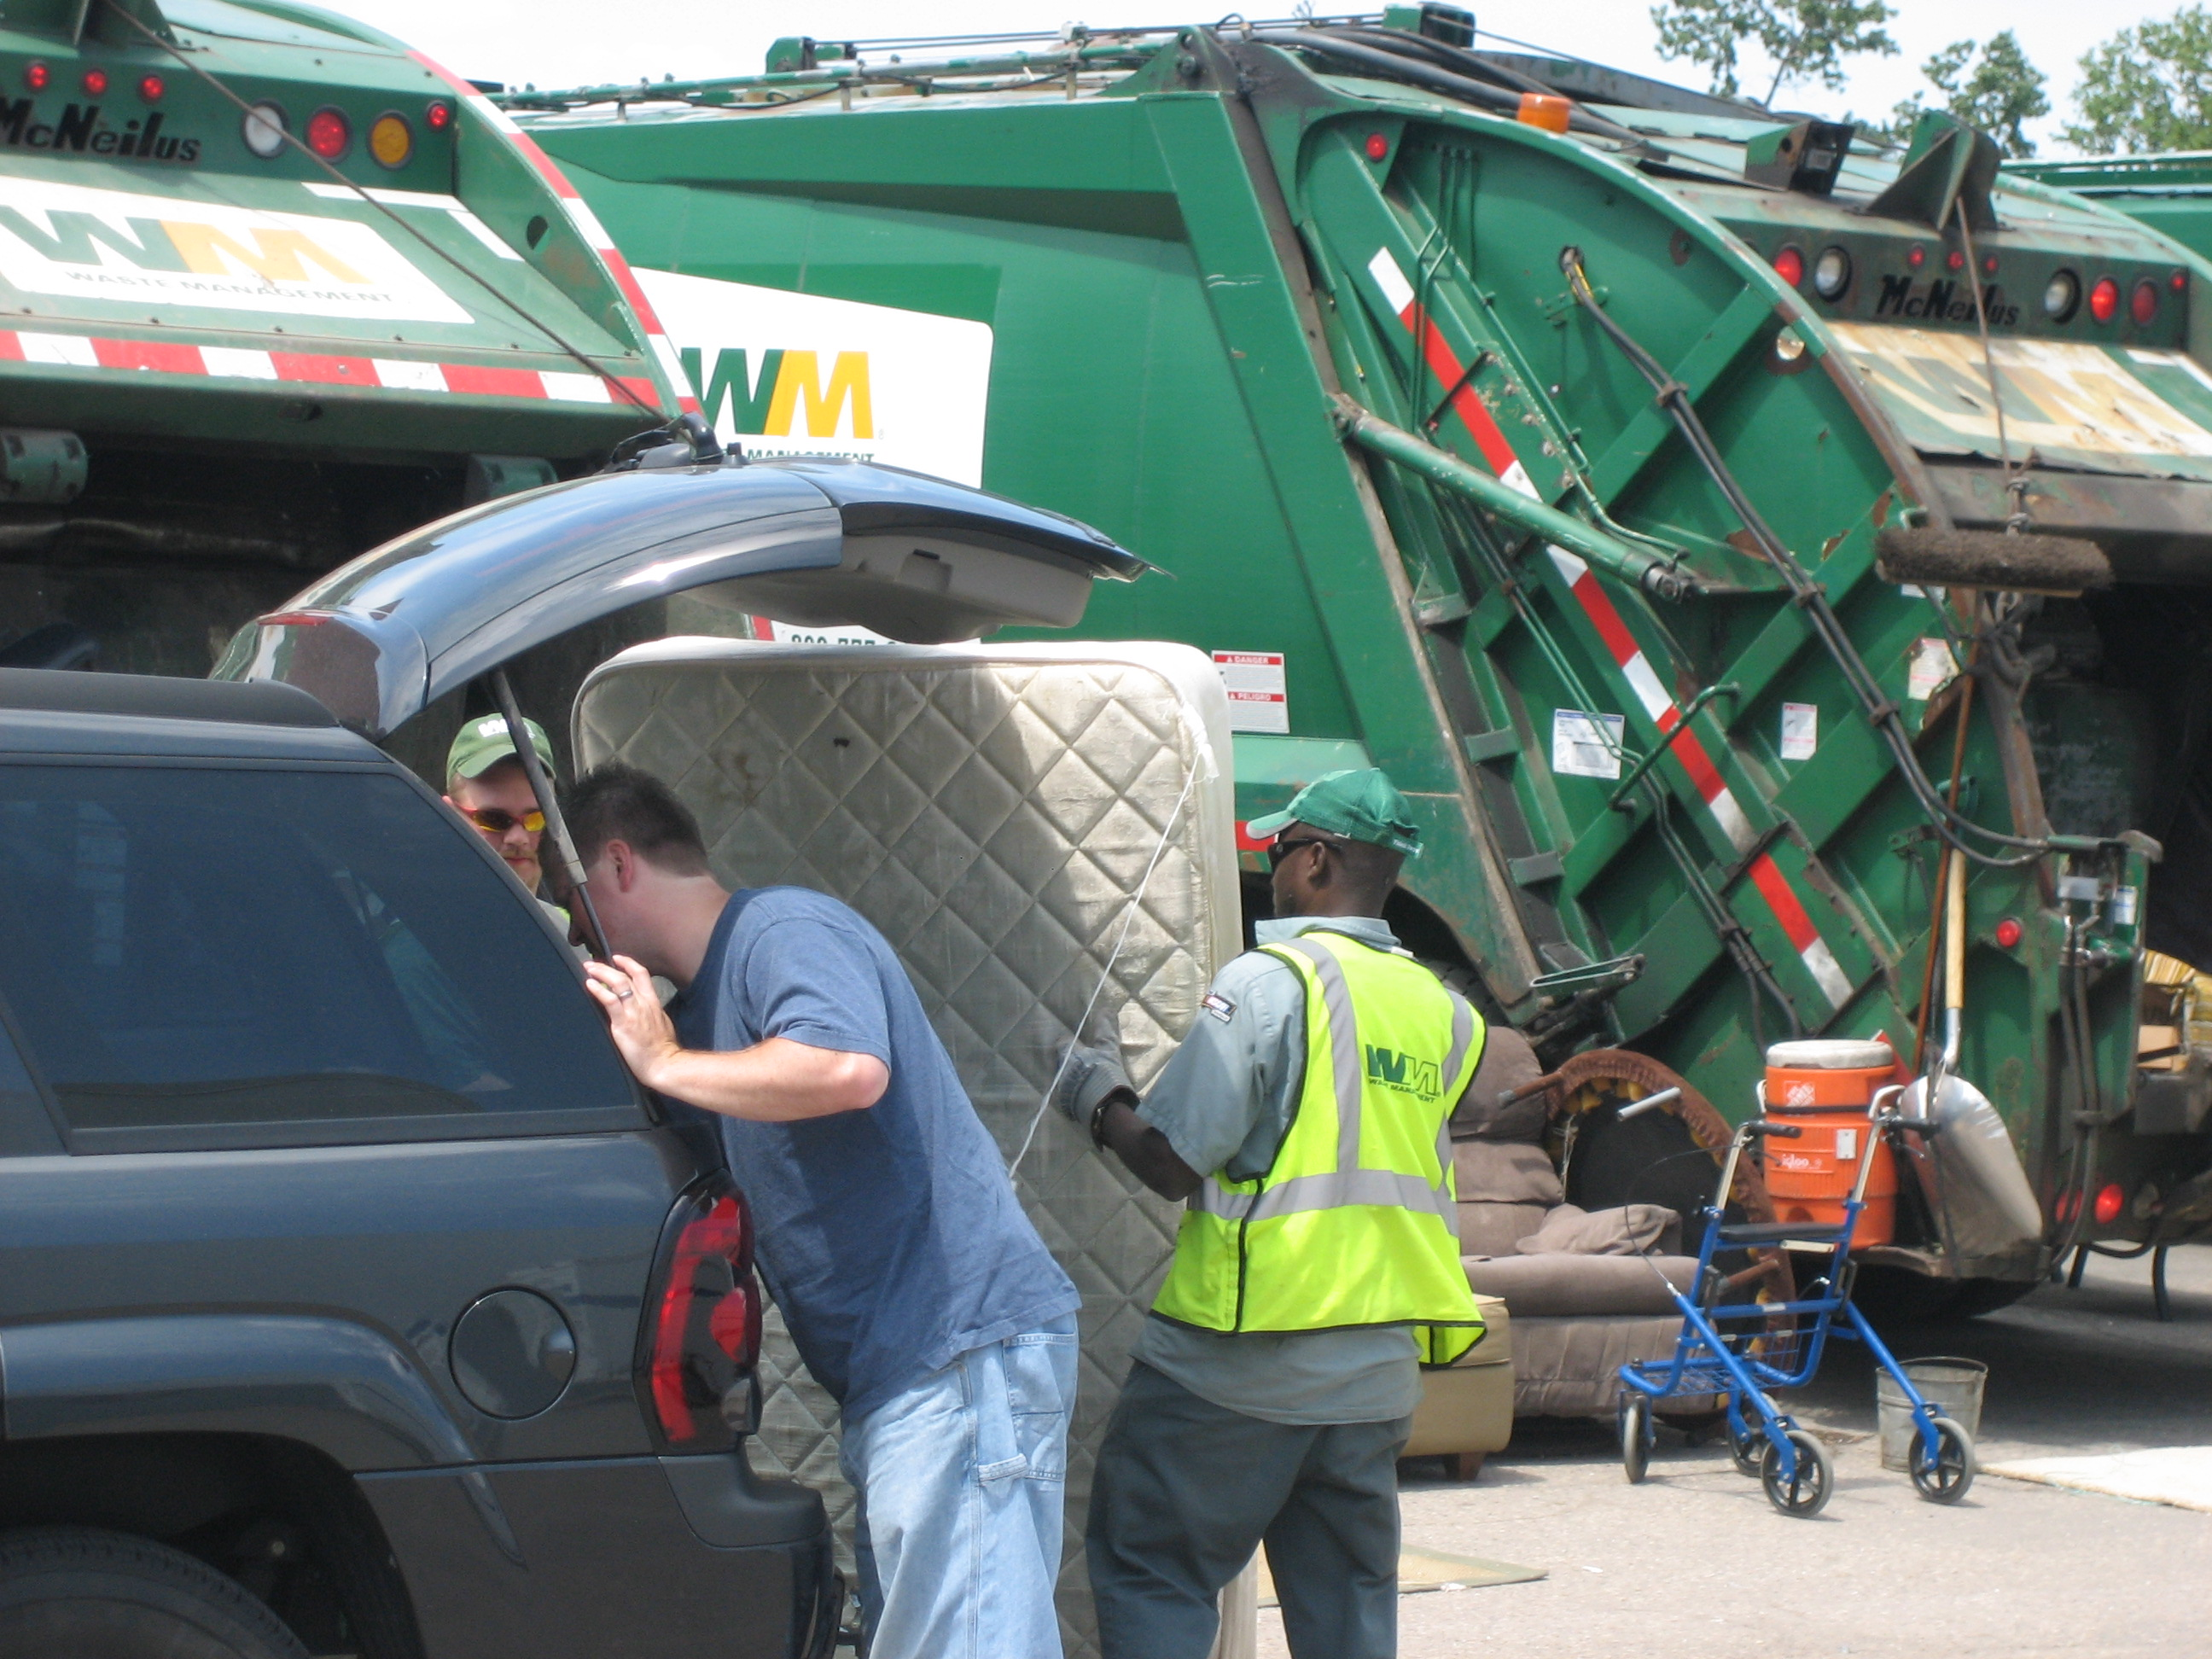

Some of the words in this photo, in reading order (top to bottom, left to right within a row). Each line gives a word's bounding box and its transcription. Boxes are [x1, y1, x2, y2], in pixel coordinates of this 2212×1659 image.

[0, 97, 201, 161] McNeilus
[0, 205, 374, 284] WM
[66, 271, 169, 288] WASTE
[180, 280, 393, 303] MANAGEMENT
[1876, 274, 2019, 326] McNeilus
[681, 346, 874, 439] WM
[1234, 655, 1269, 665] DANGER
[1237, 692, 1272, 701] PELIGRO
[1365, 1043, 1438, 1096] WM
